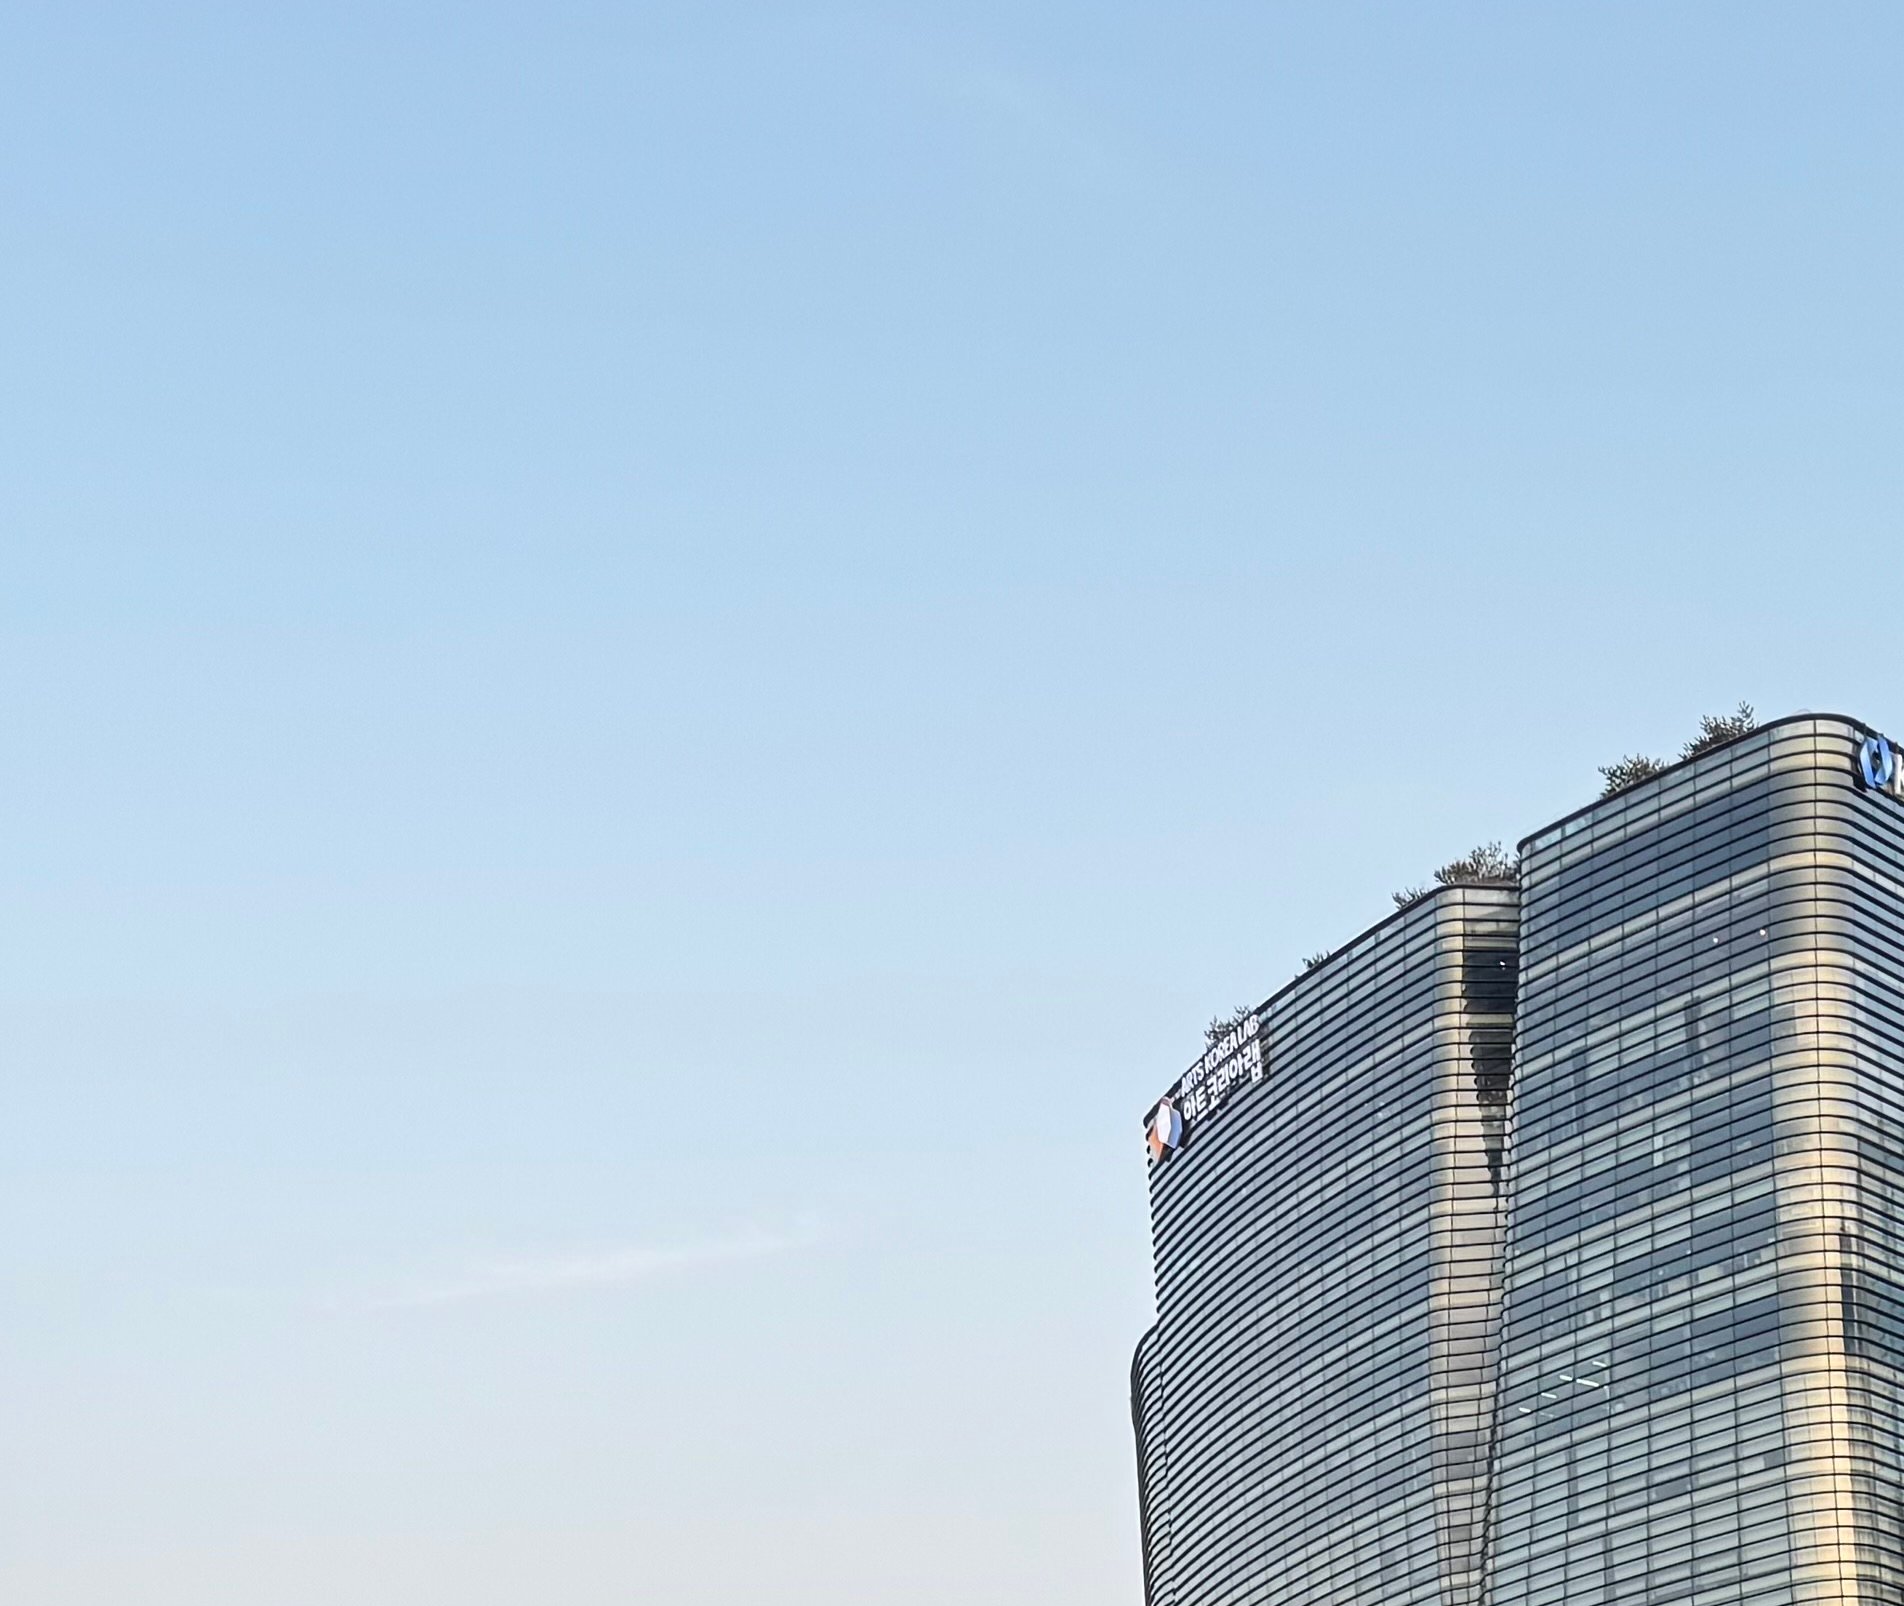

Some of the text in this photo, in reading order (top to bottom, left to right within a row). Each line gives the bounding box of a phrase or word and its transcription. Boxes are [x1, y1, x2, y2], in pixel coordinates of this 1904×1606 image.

[1203, 1034, 1240, 1072] KOREA
[1236, 1013, 1261, 1050] LAB
[1182, 1037, 1263, 1122] 아트코리아랩
